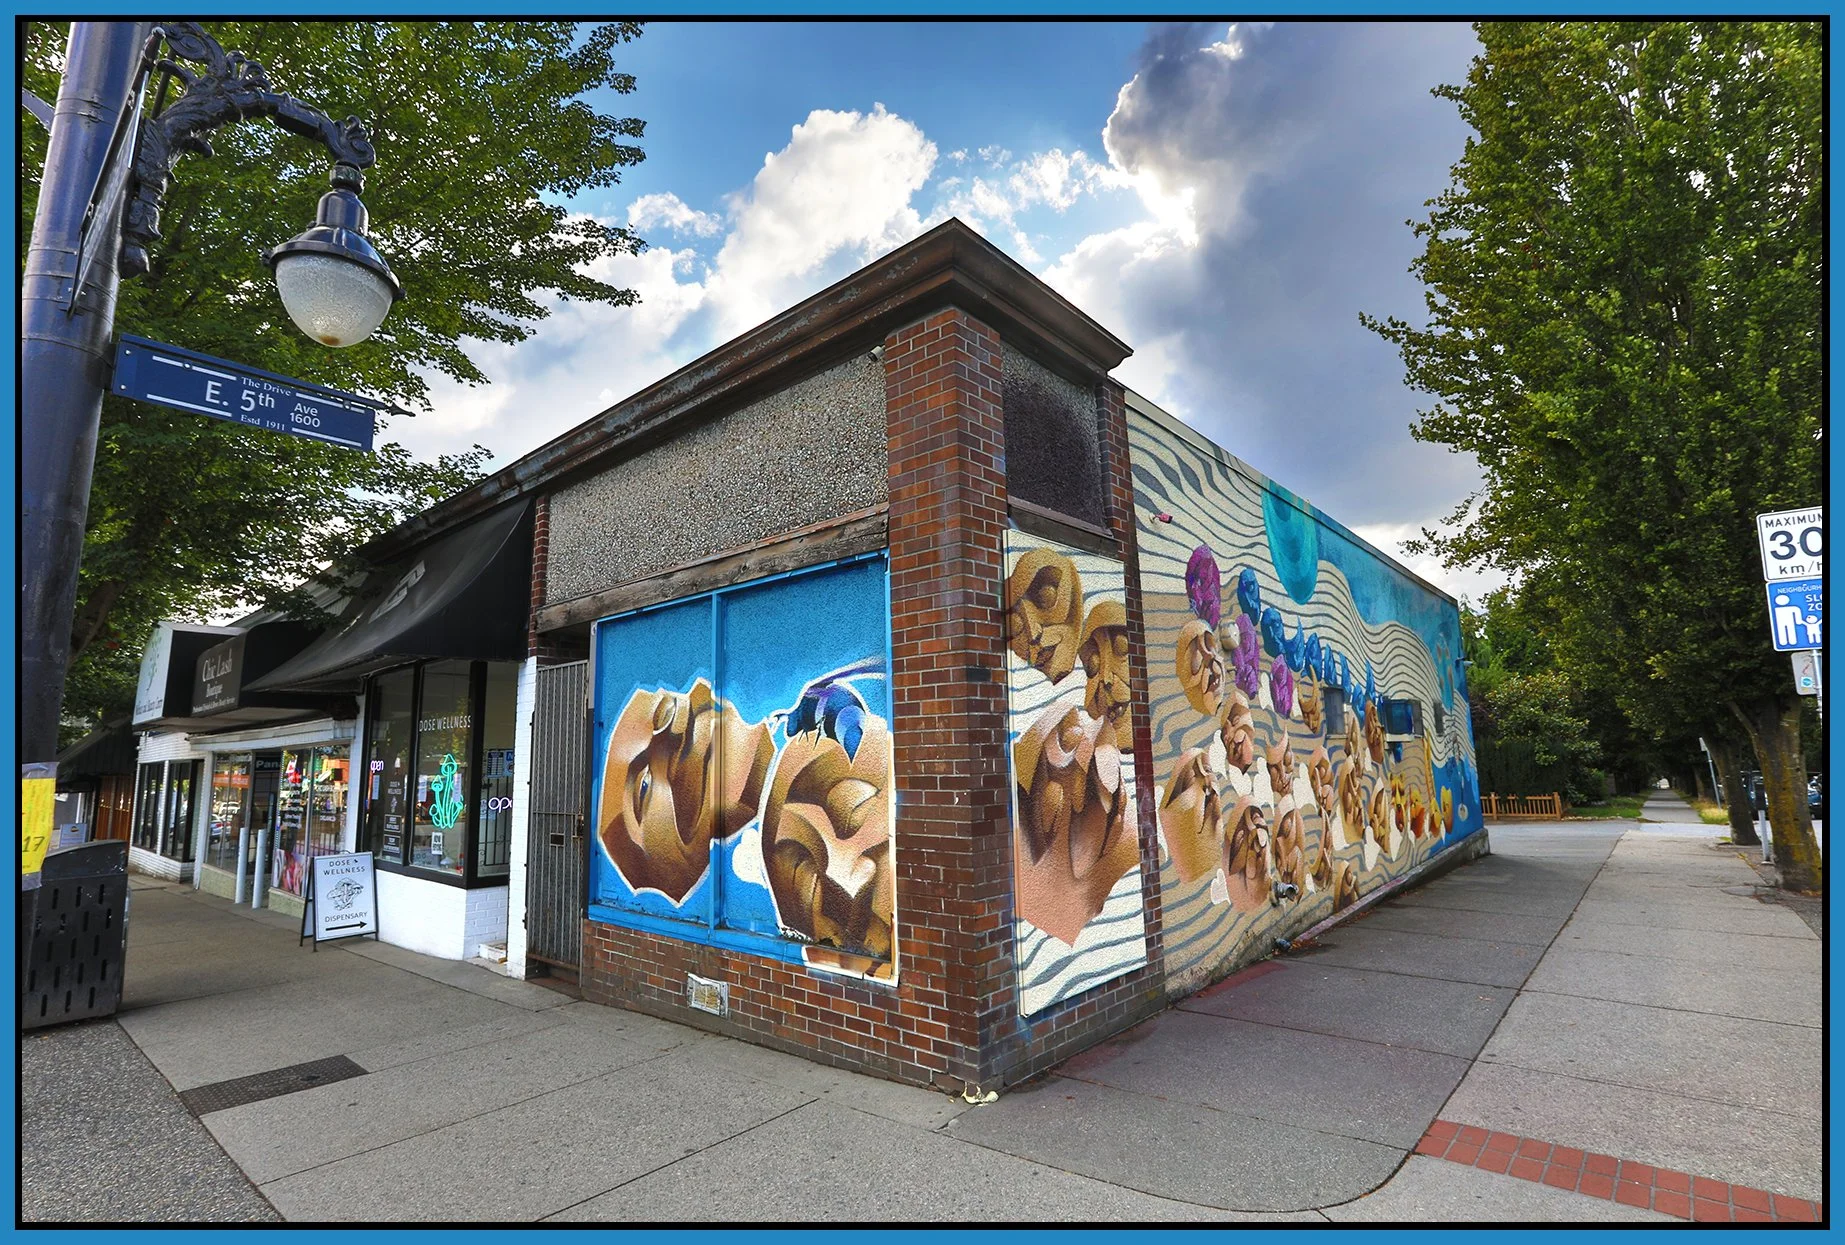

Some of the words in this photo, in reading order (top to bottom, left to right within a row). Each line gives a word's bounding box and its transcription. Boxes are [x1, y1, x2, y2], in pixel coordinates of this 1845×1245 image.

[241, 376, 261, 389] The
[263, 382, 292, 397] Drive
[205, 380, 229, 407] E.
[240, 389, 275, 412] 5th
[294, 402, 318, 417] Ave
[240, 414, 261, 426] Estd
[266, 420, 285, 431] 1911
[289, 412, 321, 428] 1600
[1769, 526, 1822, 561] 30
[1779, 560, 1822, 575] km/h
[418, 718, 436, 732] DOSE
[437, 715, 471, 730] WELLNESS
[256, 760, 280, 769] Pan
[371, 760, 384, 774] open
[329, 859, 351, 867] DOSE
[323, 866, 366, 876] WELLNESS
[324, 911, 368, 923] DISPENSARY
